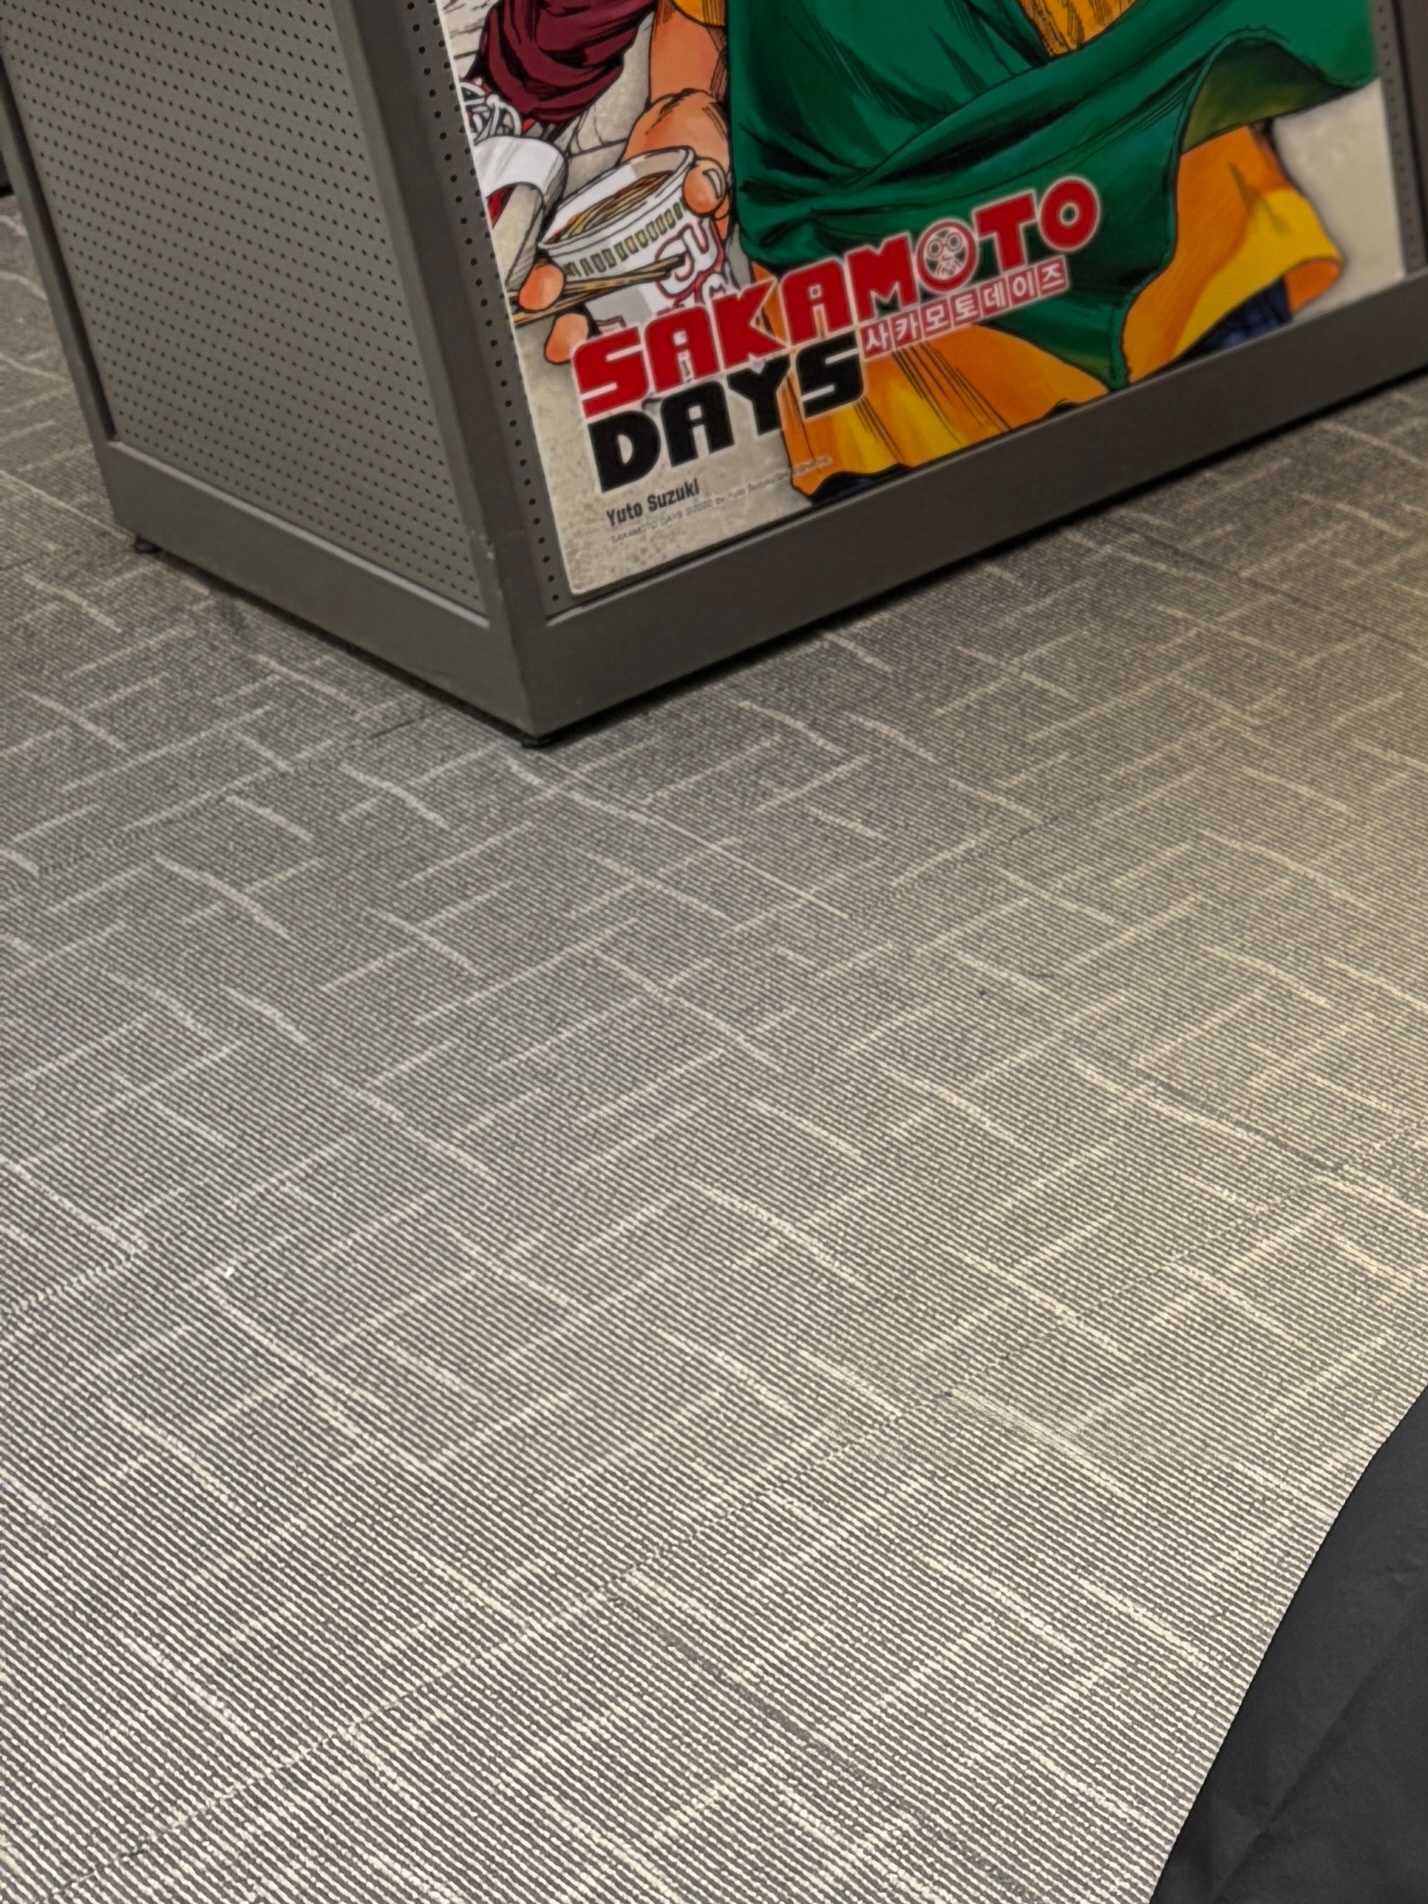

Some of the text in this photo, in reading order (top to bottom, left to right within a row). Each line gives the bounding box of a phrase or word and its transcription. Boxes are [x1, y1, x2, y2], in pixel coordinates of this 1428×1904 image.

[571, 177, 1101, 420] SAKAMOTO
[860, 255, 1070, 361] 사카모토데이즈
[586, 332, 865, 494] DAYS
[606, 478, 700, 527] Yuto Suzuki
